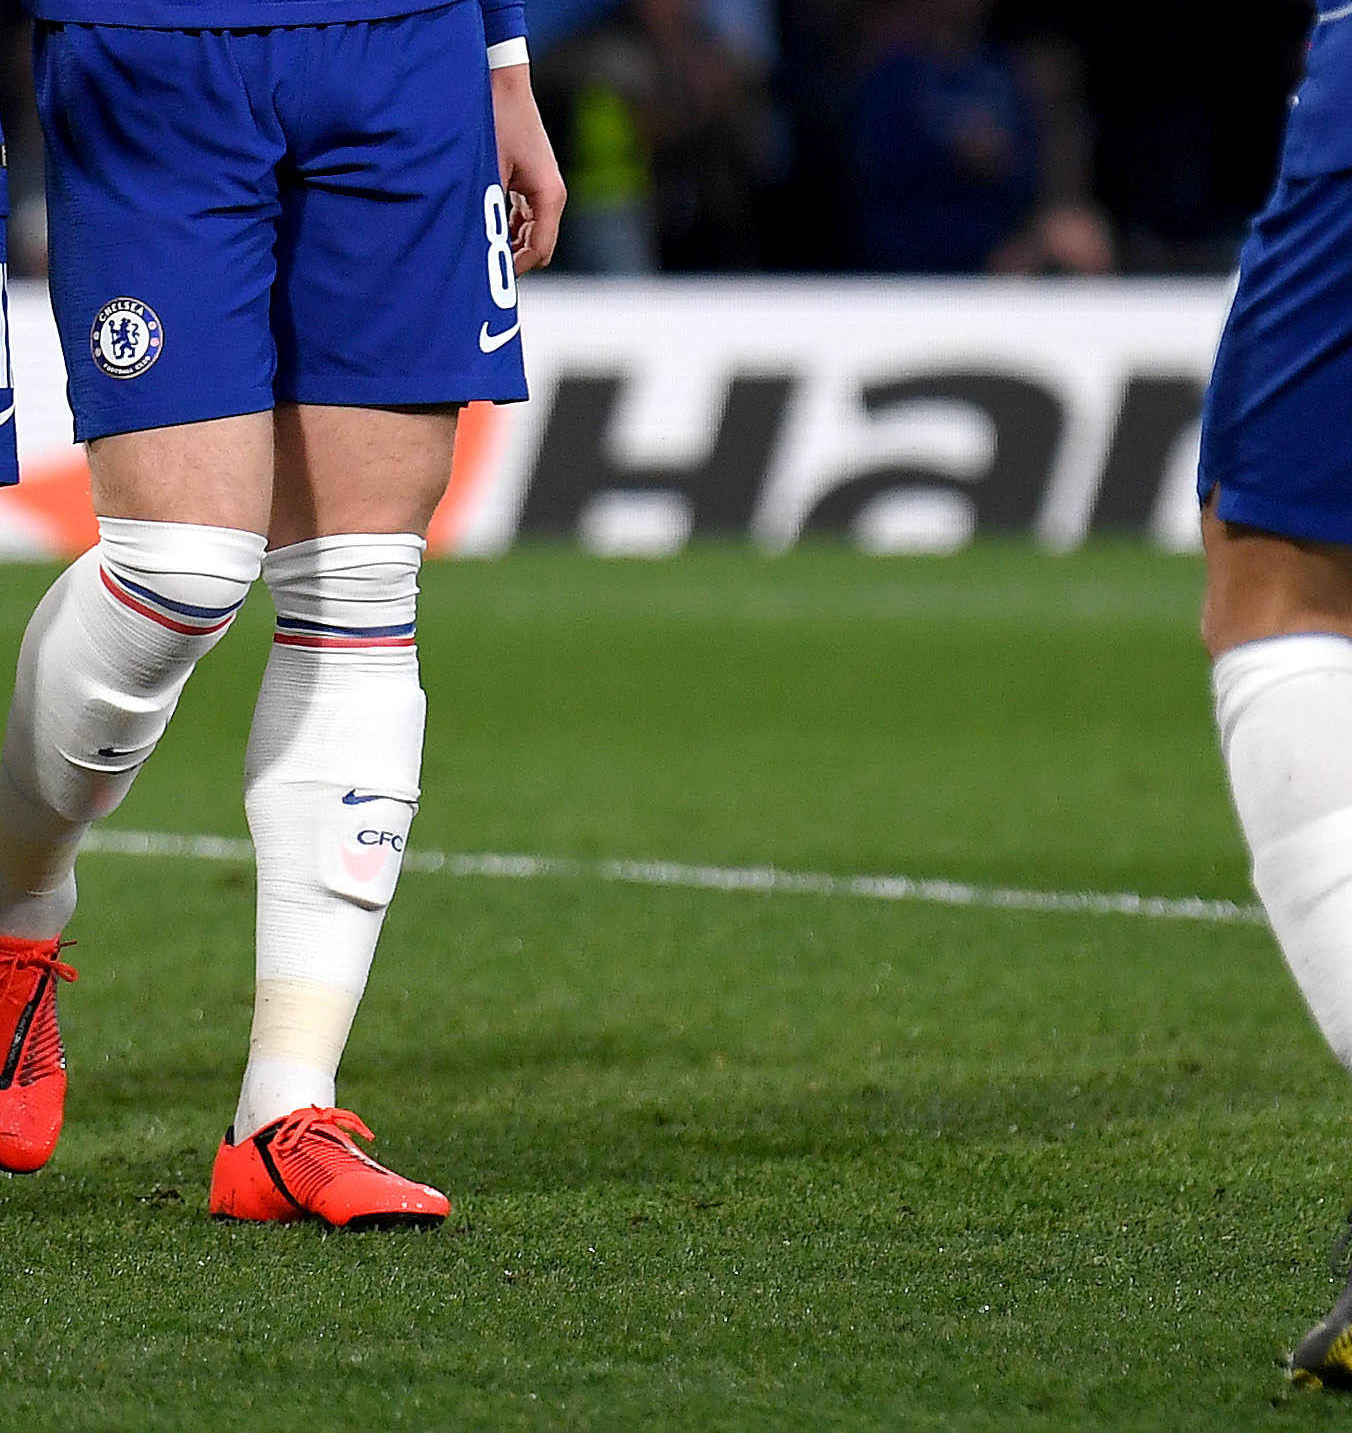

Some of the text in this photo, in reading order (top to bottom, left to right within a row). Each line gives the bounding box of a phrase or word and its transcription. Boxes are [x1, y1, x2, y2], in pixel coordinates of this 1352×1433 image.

[484, 184, 517, 309] 8
[99, 301, 144, 322] CHELSEA
[357, 830, 404, 852] CFC
